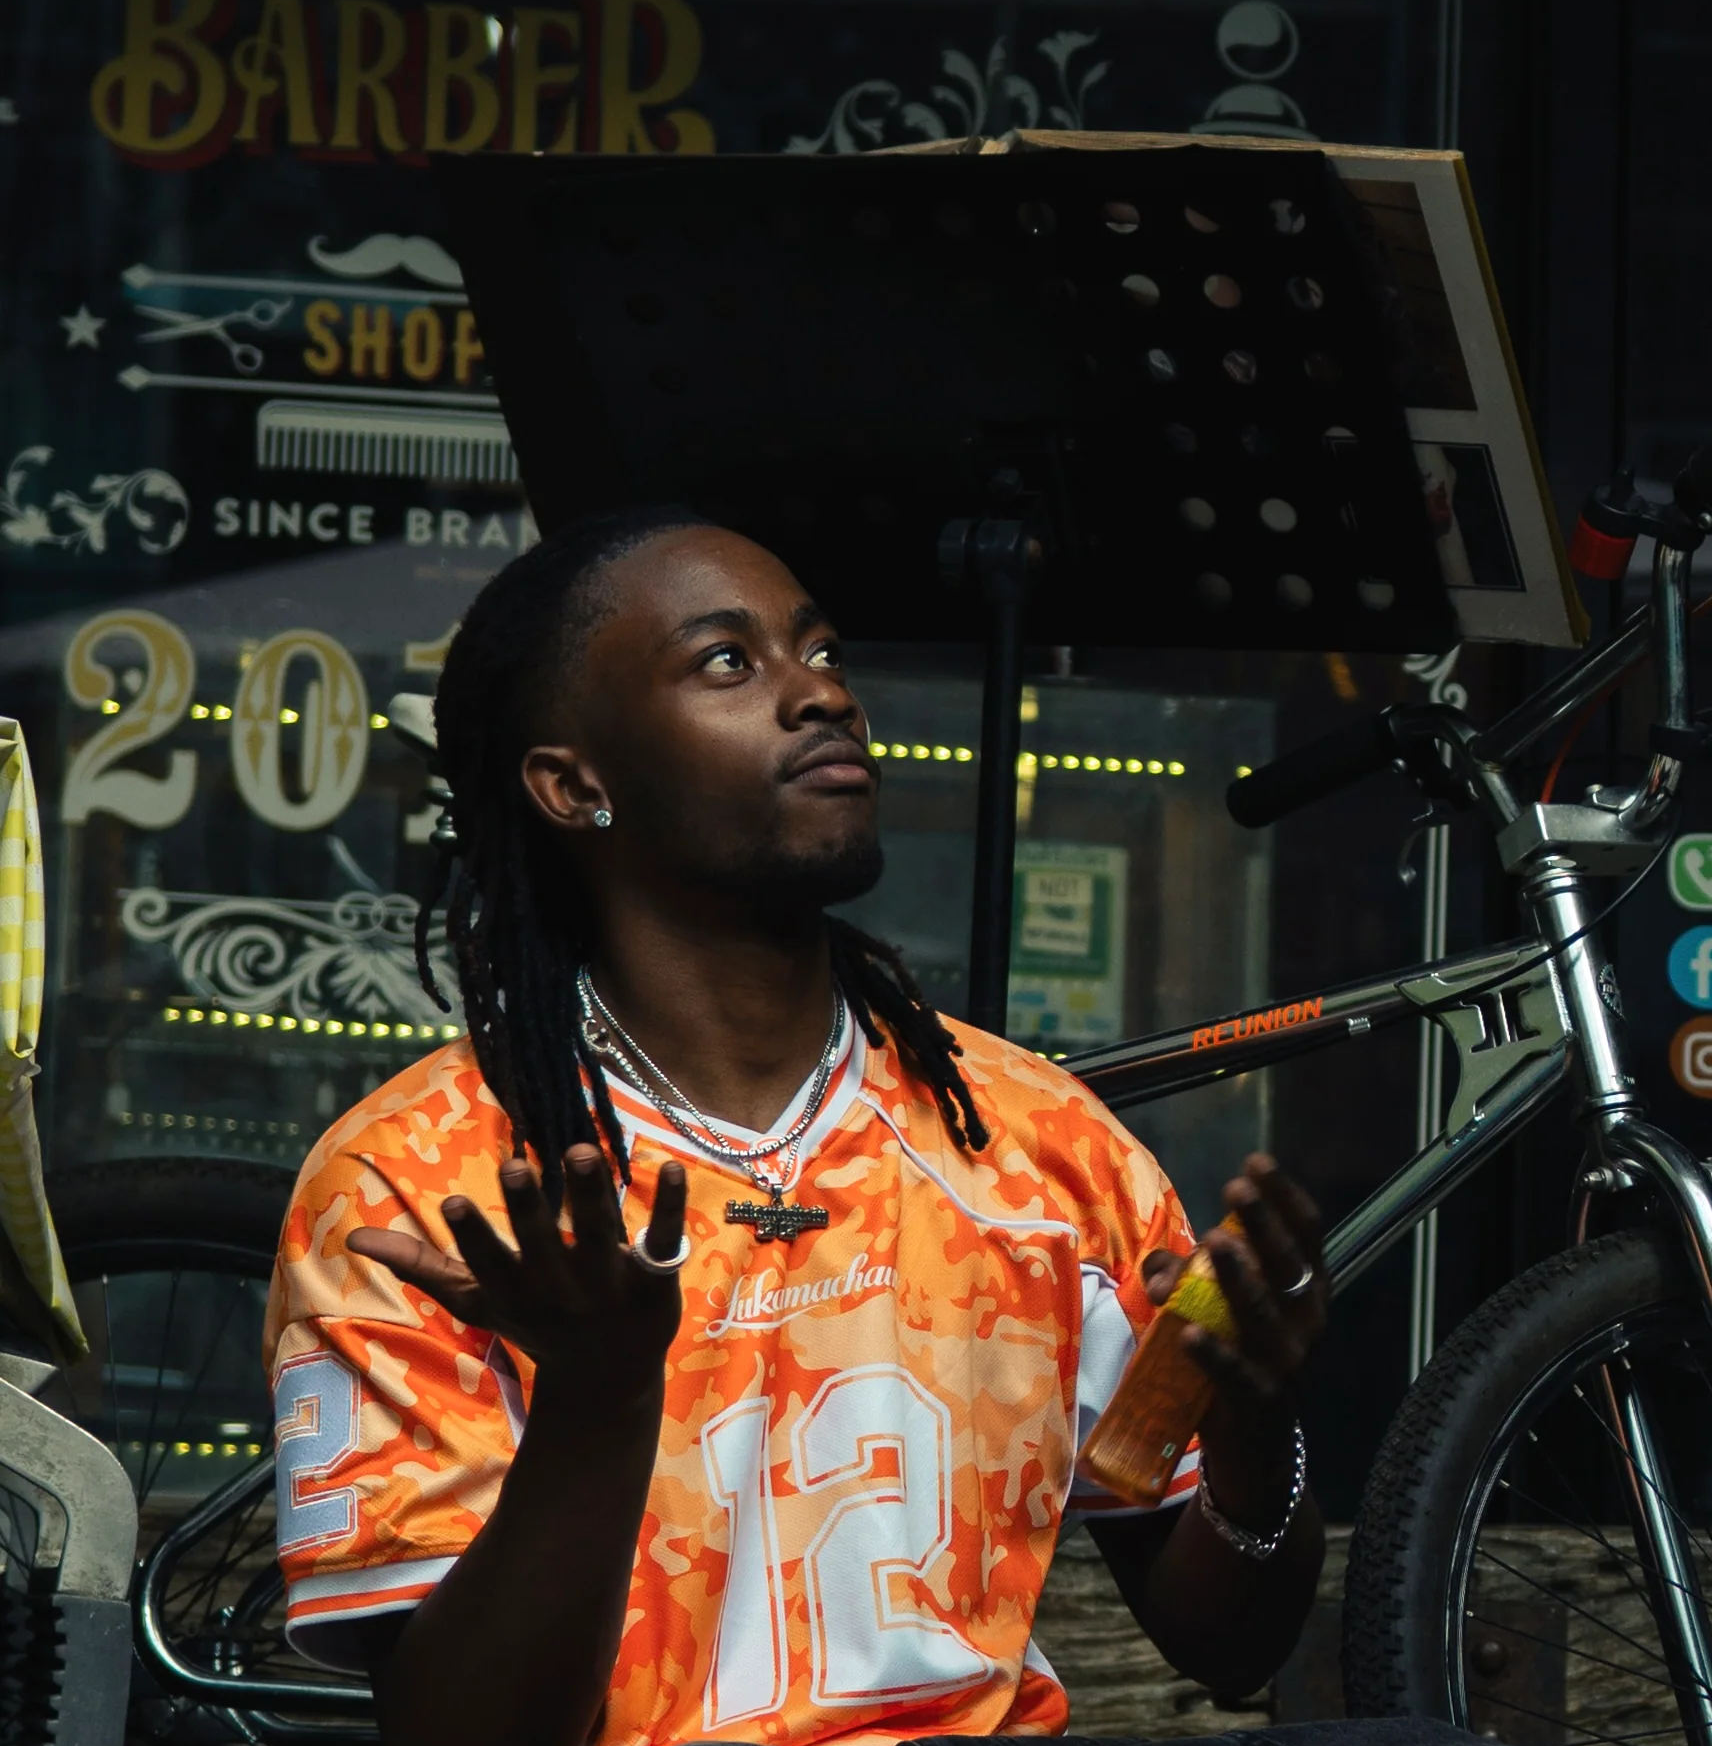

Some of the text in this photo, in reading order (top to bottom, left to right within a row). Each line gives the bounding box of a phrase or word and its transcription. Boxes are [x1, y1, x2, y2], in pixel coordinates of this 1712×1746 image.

[212, 496, 377, 545] SINCE
[1191, 996, 1324, 1053] REUNION
[700, 1362, 996, 1733] 12
